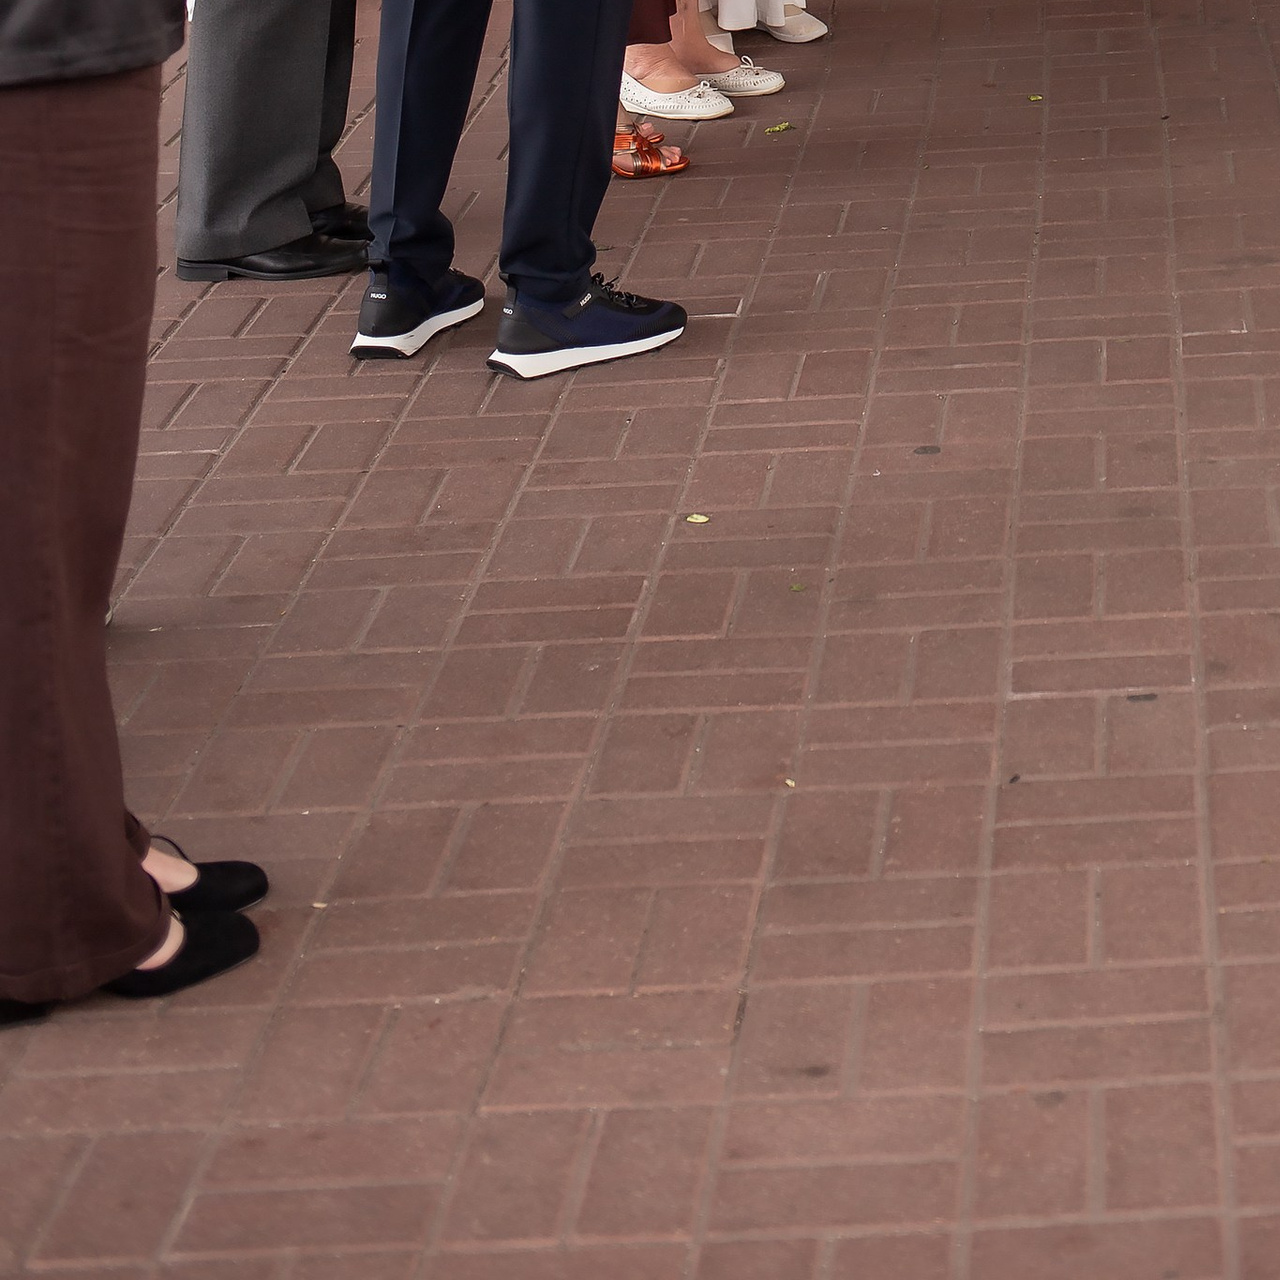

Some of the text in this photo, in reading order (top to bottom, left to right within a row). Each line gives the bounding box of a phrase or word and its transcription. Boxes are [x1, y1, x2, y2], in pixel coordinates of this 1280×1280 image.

[370, 292, 387, 300] HUGO
[580, 293, 592, 306] HUGO
[502, 307, 513, 315] UGO
